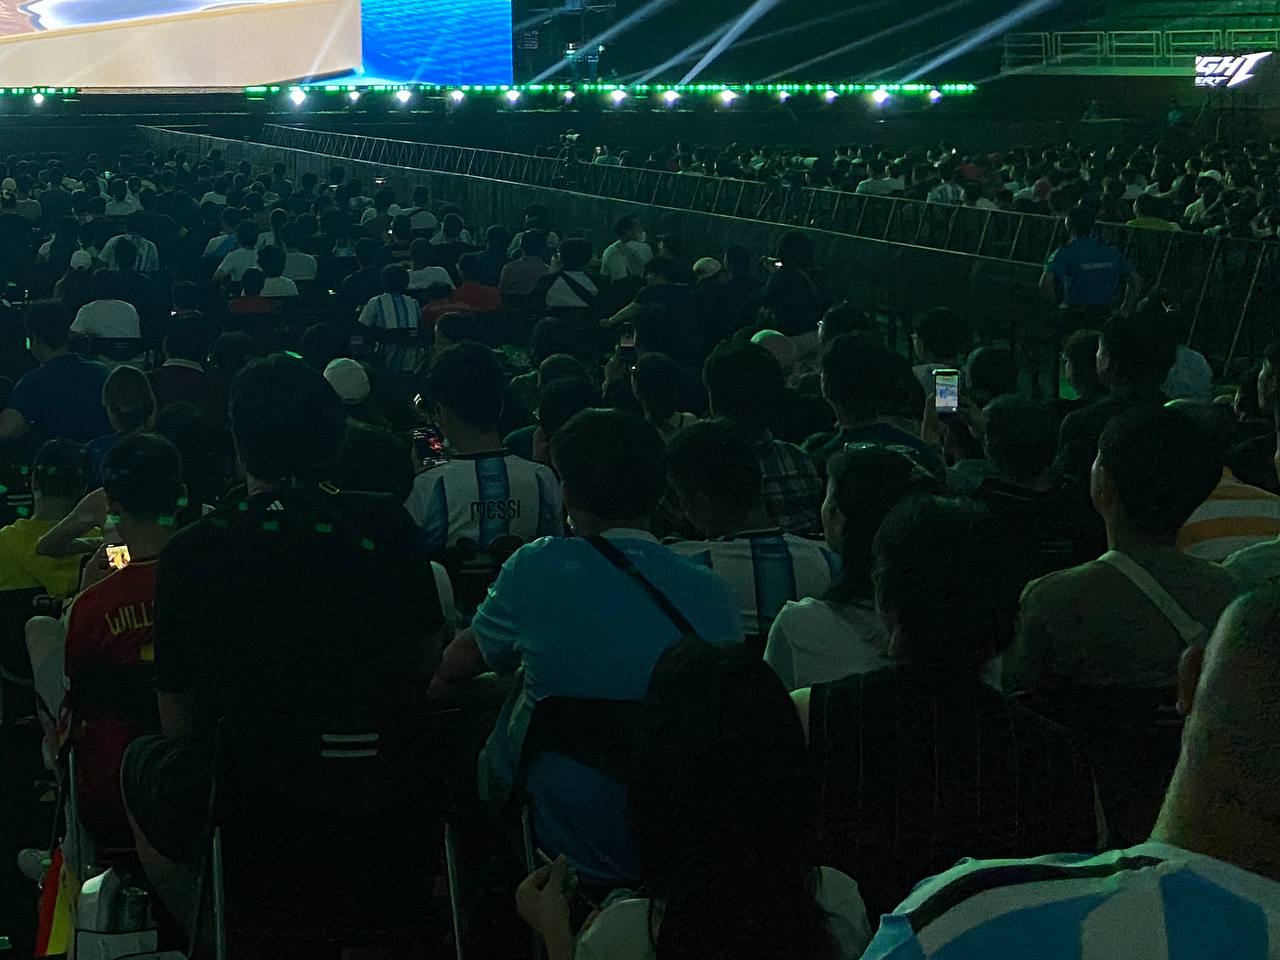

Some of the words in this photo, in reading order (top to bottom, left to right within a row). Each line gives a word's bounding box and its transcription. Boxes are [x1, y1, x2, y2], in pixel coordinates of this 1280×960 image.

[1195, 51, 1272, 87] GHT
[469, 499, 521, 521] MESSI
[105, 601, 154, 636] WILL
